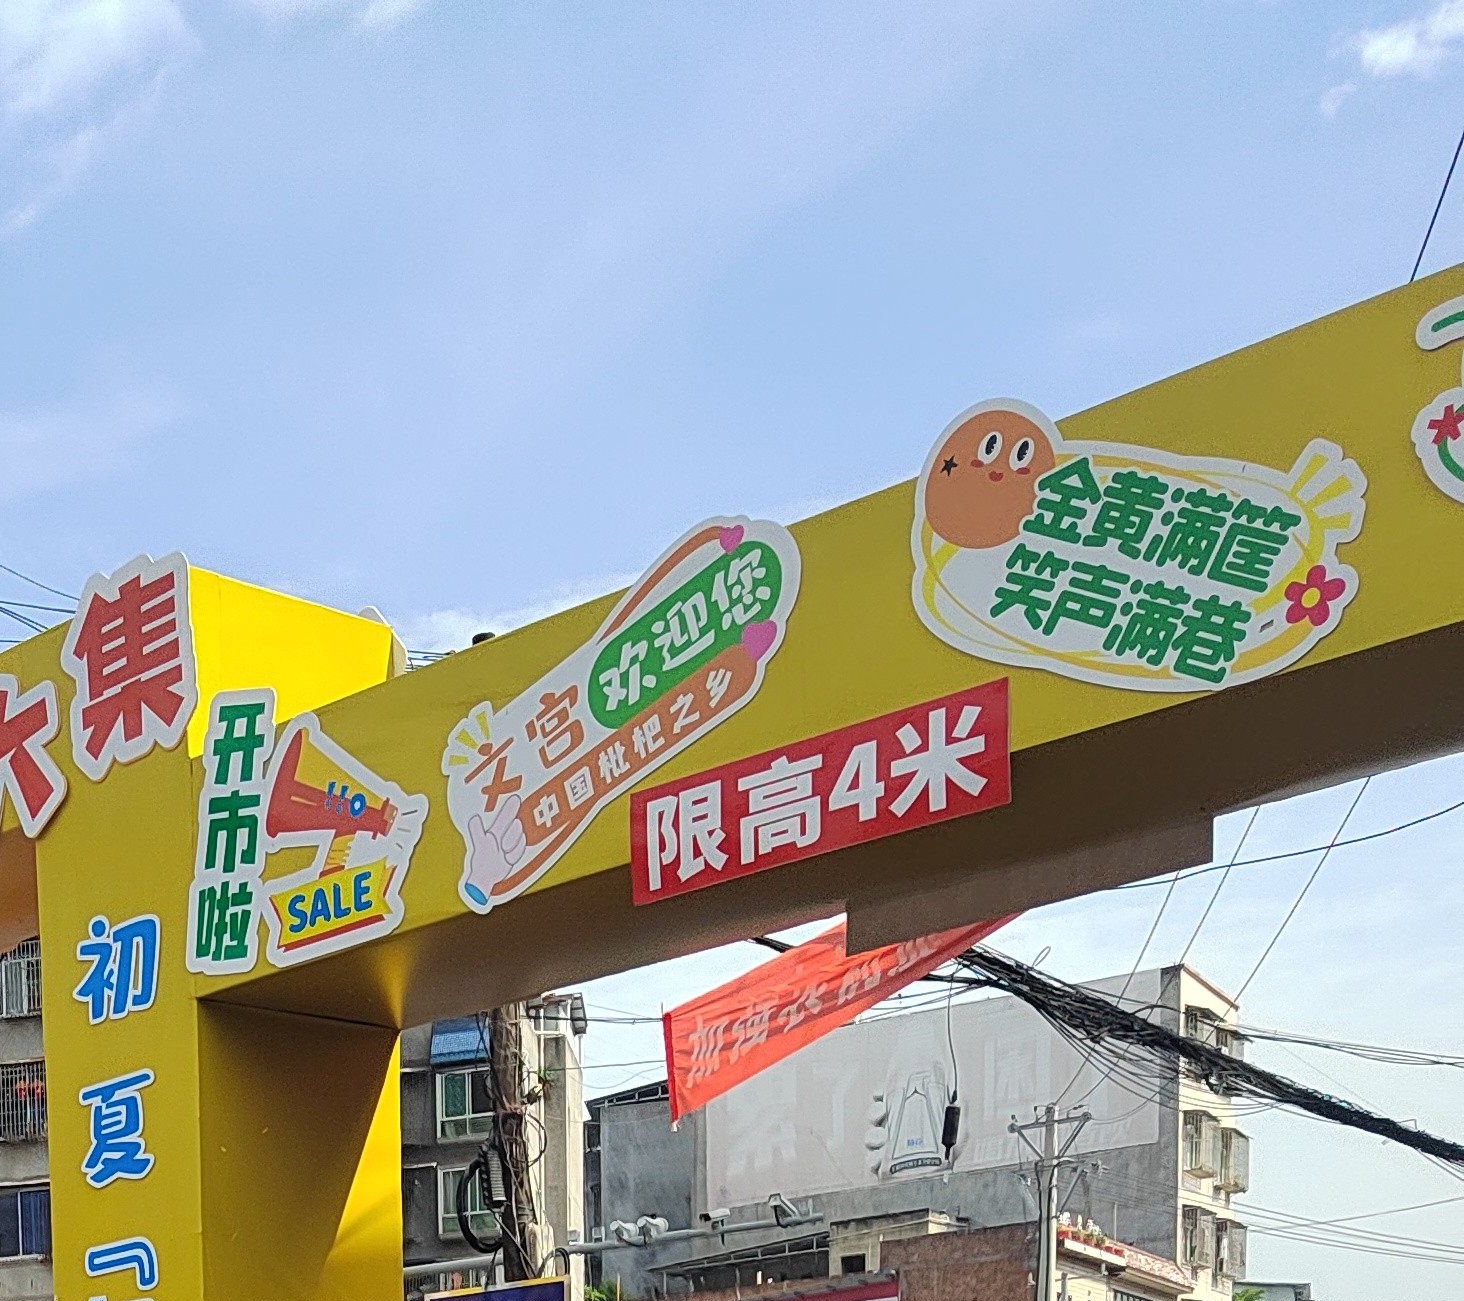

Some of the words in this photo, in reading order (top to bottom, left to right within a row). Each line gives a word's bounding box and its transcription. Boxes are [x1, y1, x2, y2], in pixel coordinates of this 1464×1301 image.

[1022, 457, 1302, 594] 金黄满筐
[597, 548, 772, 712] 欢迎您
[989, 543, 1253, 684] 笑声满巷
[463, 684, 585, 813] 文宫
[533, 668, 733, 829] 中国枇杷之乡
[646, 705, 989, 892] 限高4米
[195, 701, 266, 962] 开市啦
[287, 870, 373, 934] SALE
